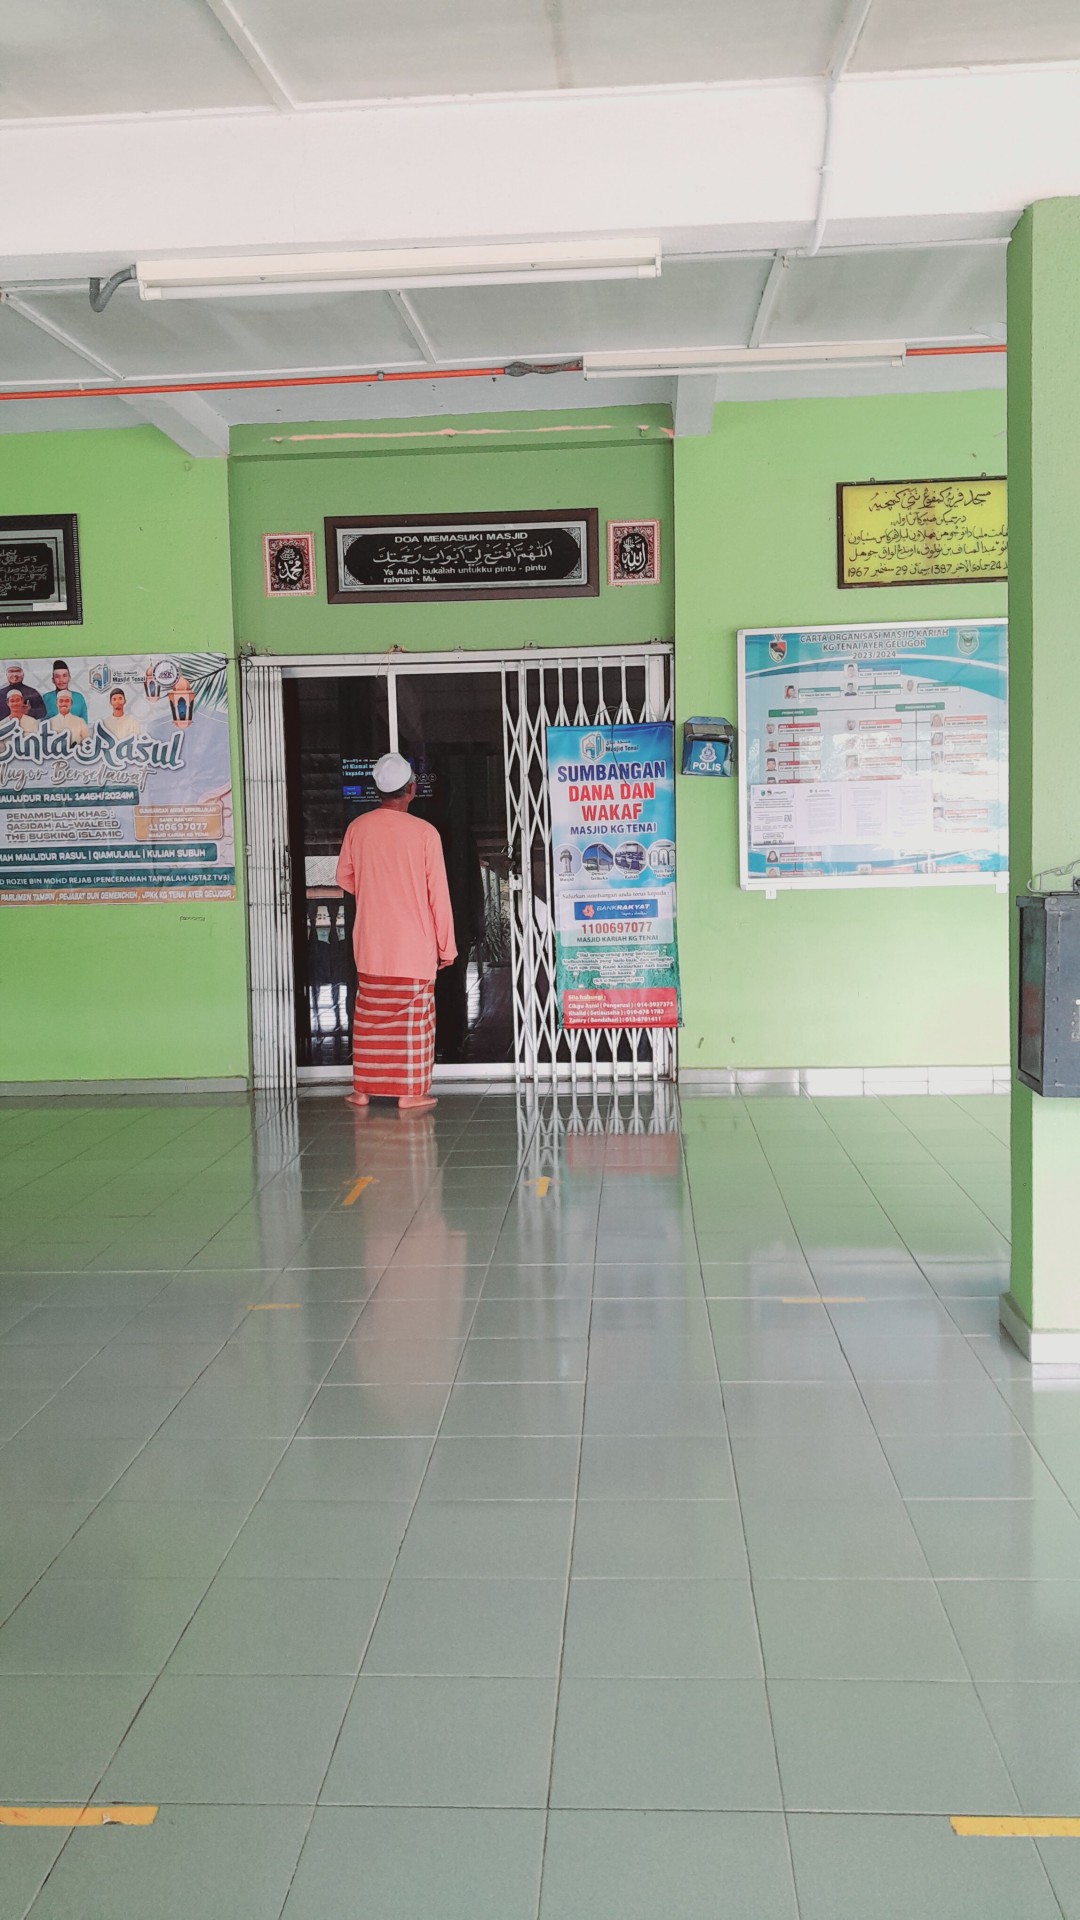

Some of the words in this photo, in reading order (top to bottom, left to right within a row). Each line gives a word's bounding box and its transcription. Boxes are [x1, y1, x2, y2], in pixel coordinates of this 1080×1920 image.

[423, 534, 483, 543] MEMASUKI
[486, 532, 528, 540] MASJID
[383, 568, 394, 576] Ya
[397, 568, 420, 576] Allah,
[423, 567, 455, 575] bukalah
[458, 566, 492, 574] untukku
[494, 565, 516, 574] pintu
[525, 564, 547, 572] pintu
[848, 566, 870, 578] 1967
[896, 565, 908, 576] 29
[931, 564, 952, 574] 1387
[800, 634, 827, 643] CARTA
[829, 631, 882, 642] ORGANISASI
[883, 630, 914, 639] MASJID
[916, 628, 949, 638] KARIAH
[823, 643, 835, 651] KG
[837, 642, 862, 650] TENAI
[863, 640, 885, 649] AYER
[886, 639, 926, 648] GELUGOR
[852, 651, 896, 659] 2023/2024
[75, 720, 184, 769] Rasul
[557, 761, 666, 783] SUMBANGAN
[692, 762, 721, 771] POLIS
[568, 784, 614, 802] DANA
[620, 782, 655, 800] DAN
[0, 794, 41, 803] AULUDUR
[43, 793, 73, 802] RASUL
[6, 811, 76, 820] PENAMPILAN
[78, 810, 108, 818] KHAS
[581, 803, 642, 822] WAKAF
[6, 822, 52, 831] QASIDAH
[55, 820, 119, 829] AL-WALEED
[148, 823, 208, 831] 1100697077
[570, 825, 608, 835] MASJID
[611, 824, 624, 834] KG
[627, 823, 657, 833] TENAI
[5, 833, 26, 841] THE
[29, 832, 76, 840] BUSKING
[78, 830, 123, 839] ISLAMIC
[15, 852, 57, 861] MAULIDUR
[59, 851, 87, 860] RASUL
[147, 849, 175, 858] KULIAH
[177, 848, 206, 857] SUBUH
[69, 876, 92, 884] REJAB
[93, 875, 147, 884] (PENCERAMAH
[581, 921, 653, 934] 1100697077
